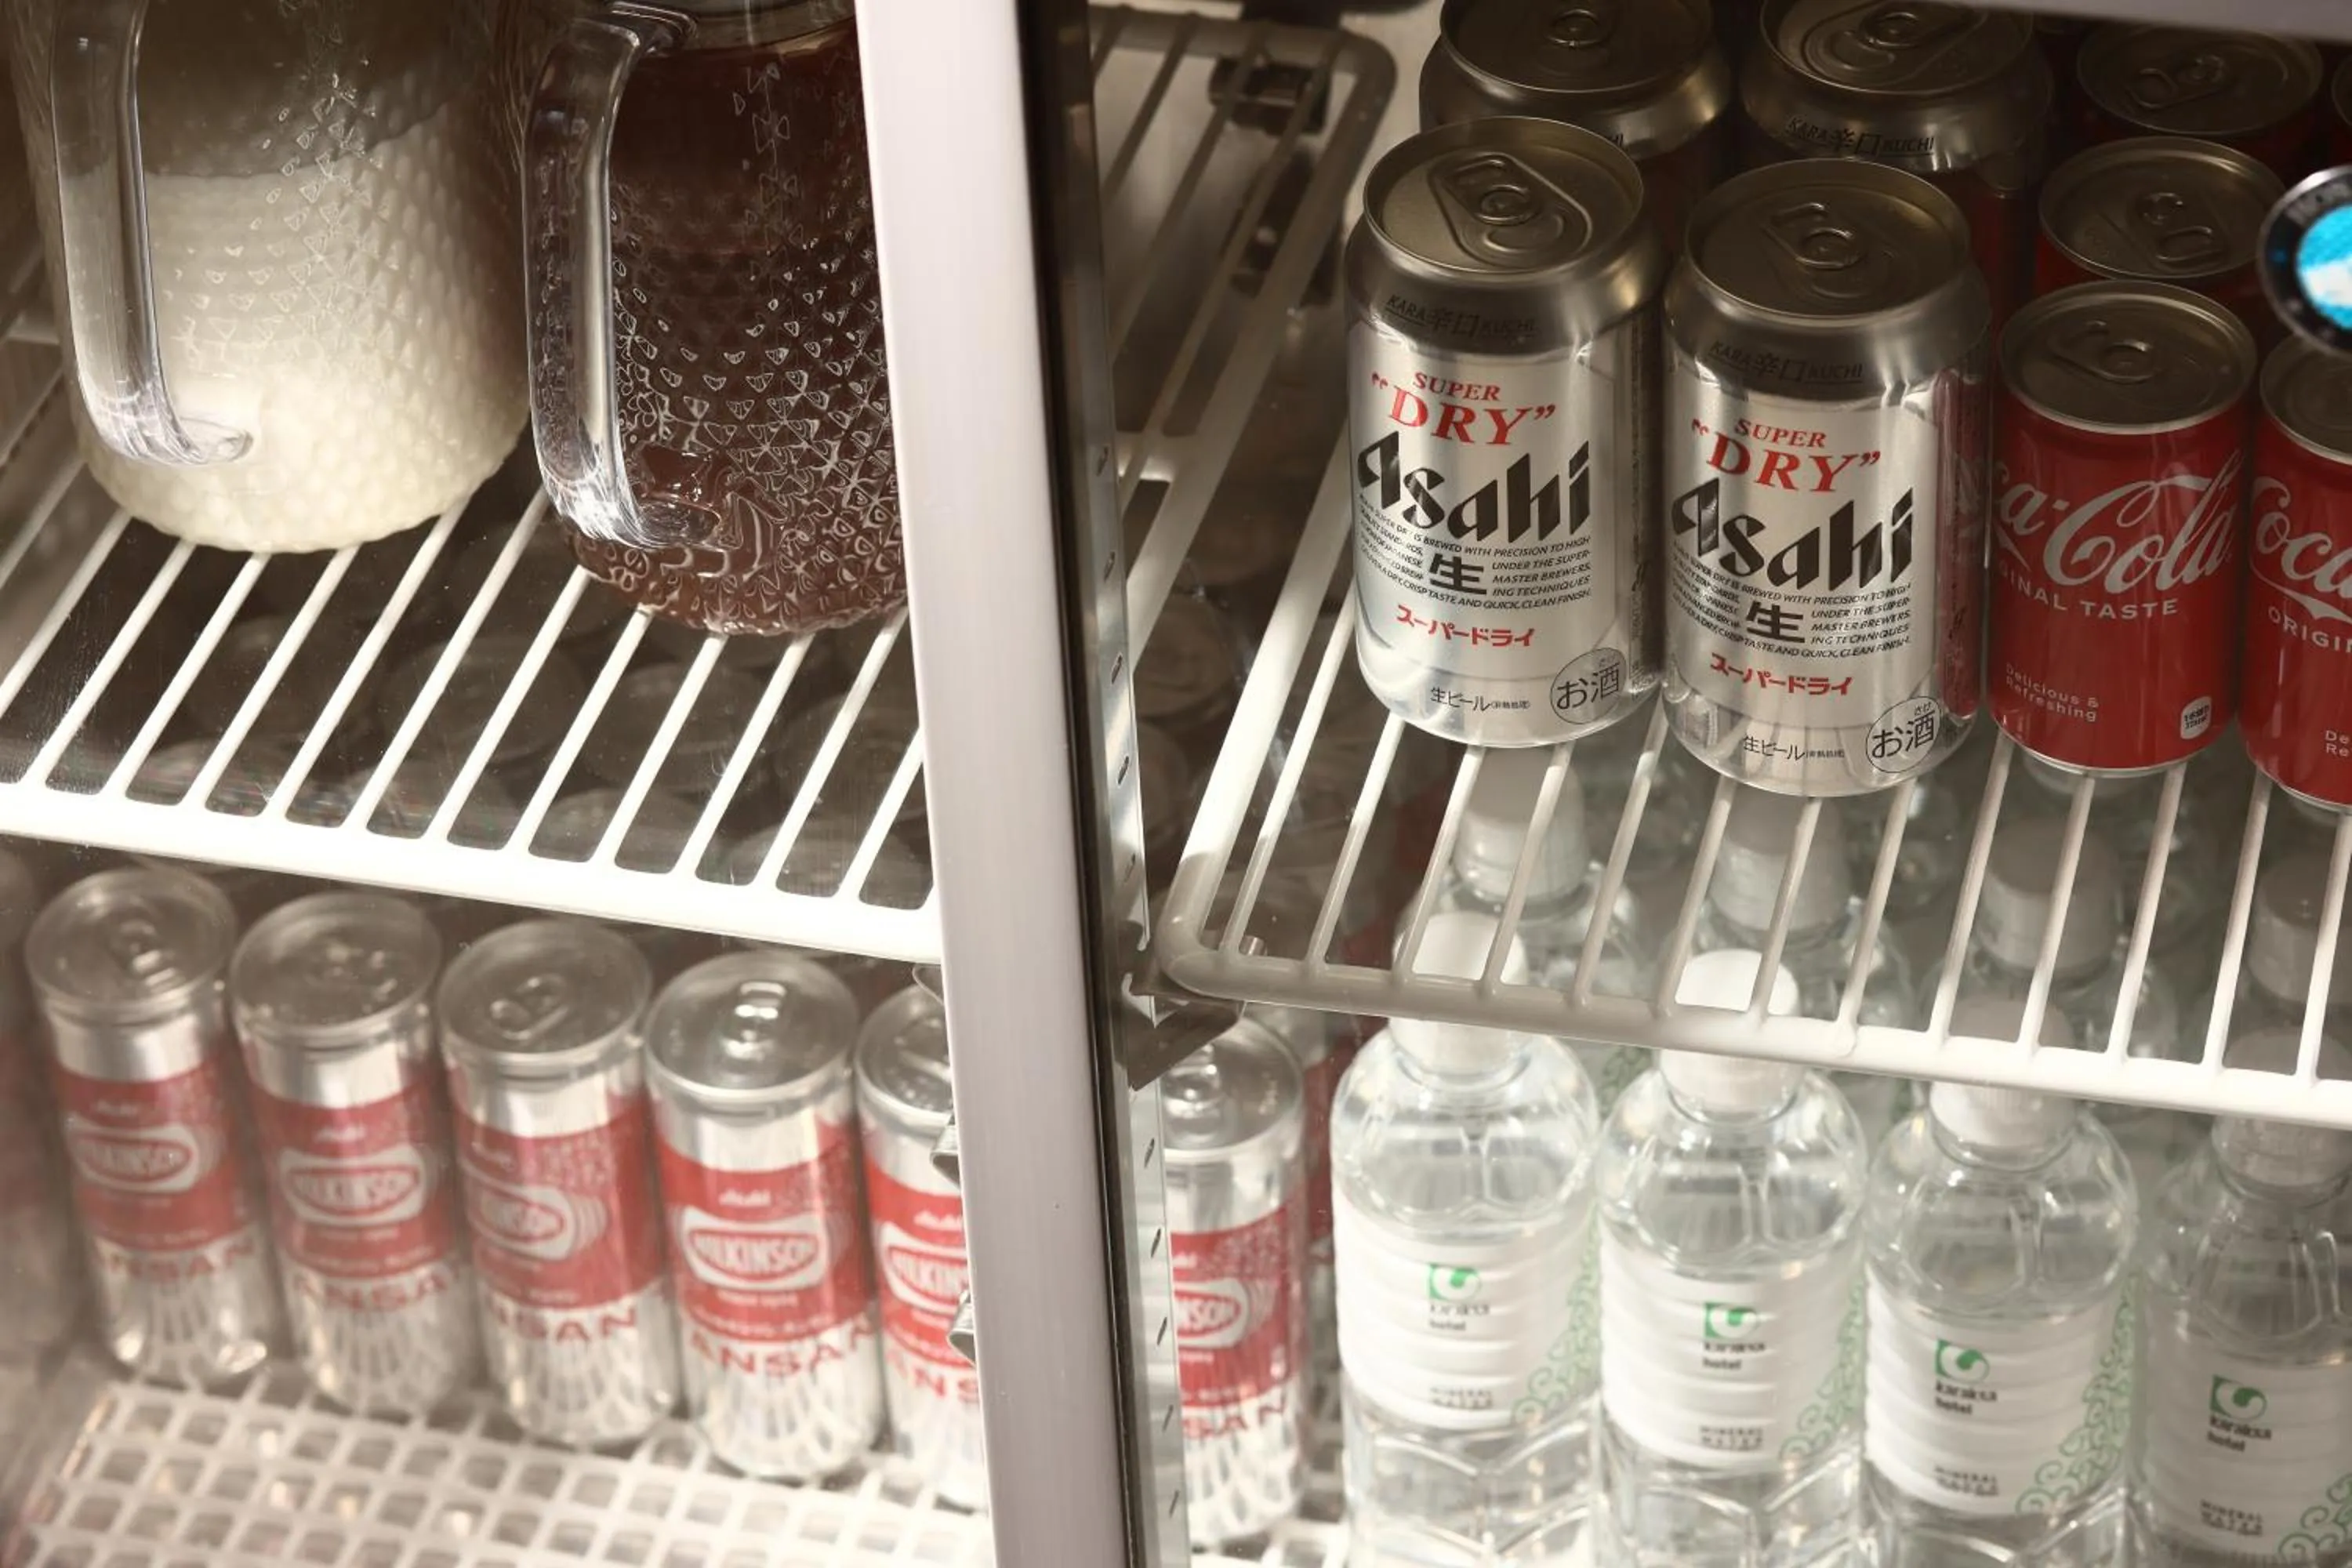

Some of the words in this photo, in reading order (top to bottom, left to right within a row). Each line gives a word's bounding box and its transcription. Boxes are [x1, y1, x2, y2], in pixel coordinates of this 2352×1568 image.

[1412, 372, 1501, 402] SUPER
[1733, 417, 1827, 449] SUPER
[1357, 430, 1591, 544] Asahi
[1423, 535, 1462, 553] BREWED
[1463, 545, 1491, 557] WITH
[1493, 545, 1548, 557] PRECISION
[1671, 477, 1913, 591] Asahi
[1429, 553, 1487, 595] 生
[1492, 560, 1531, 571] UNDER
[1533, 557, 1554, 568] THE
[1492, 573, 1539, 584] MASTER
[1428, 590, 1457, 604] TASTE
[1458, 598, 1482, 608] AND
[1521, 597, 1556, 610] CLEAN
[1492, 588, 1514, 597] ING
[1516, 575, 1592, 597] TECHNIQUES
[1741, 585, 1782, 601] BREWED
[1783, 593, 1812, 604] WITH
[1813, 594, 1868, 605] PRECISION
[1745, 601, 1805, 644] 生
[1810, 608, 1850, 619] UNDER
[1853, 606, 1875, 617] THE
[2079, 597, 2180, 620] TASTE
[1396, 603, 1536, 648] スーパードライ
[1809, 622, 1859, 632] MASTER
[1809, 636, 1835, 645] ING
[1835, 623, 1910, 644] TECHNIQUES
[2267, 605, 2352, 653] ORIGI
[1744, 637, 1775, 652] TASTE
[1775, 646, 1800, 657] AND
[1839, 645, 1875, 658] CLEAN
[1556, 662, 1621, 710] お酒
[1710, 652, 1854, 696] スーパードライ
[2005, 662, 2081, 706] Delicious
[2005, 675, 2098, 723] Refreshing
[1871, 709, 1936, 758] お酒
